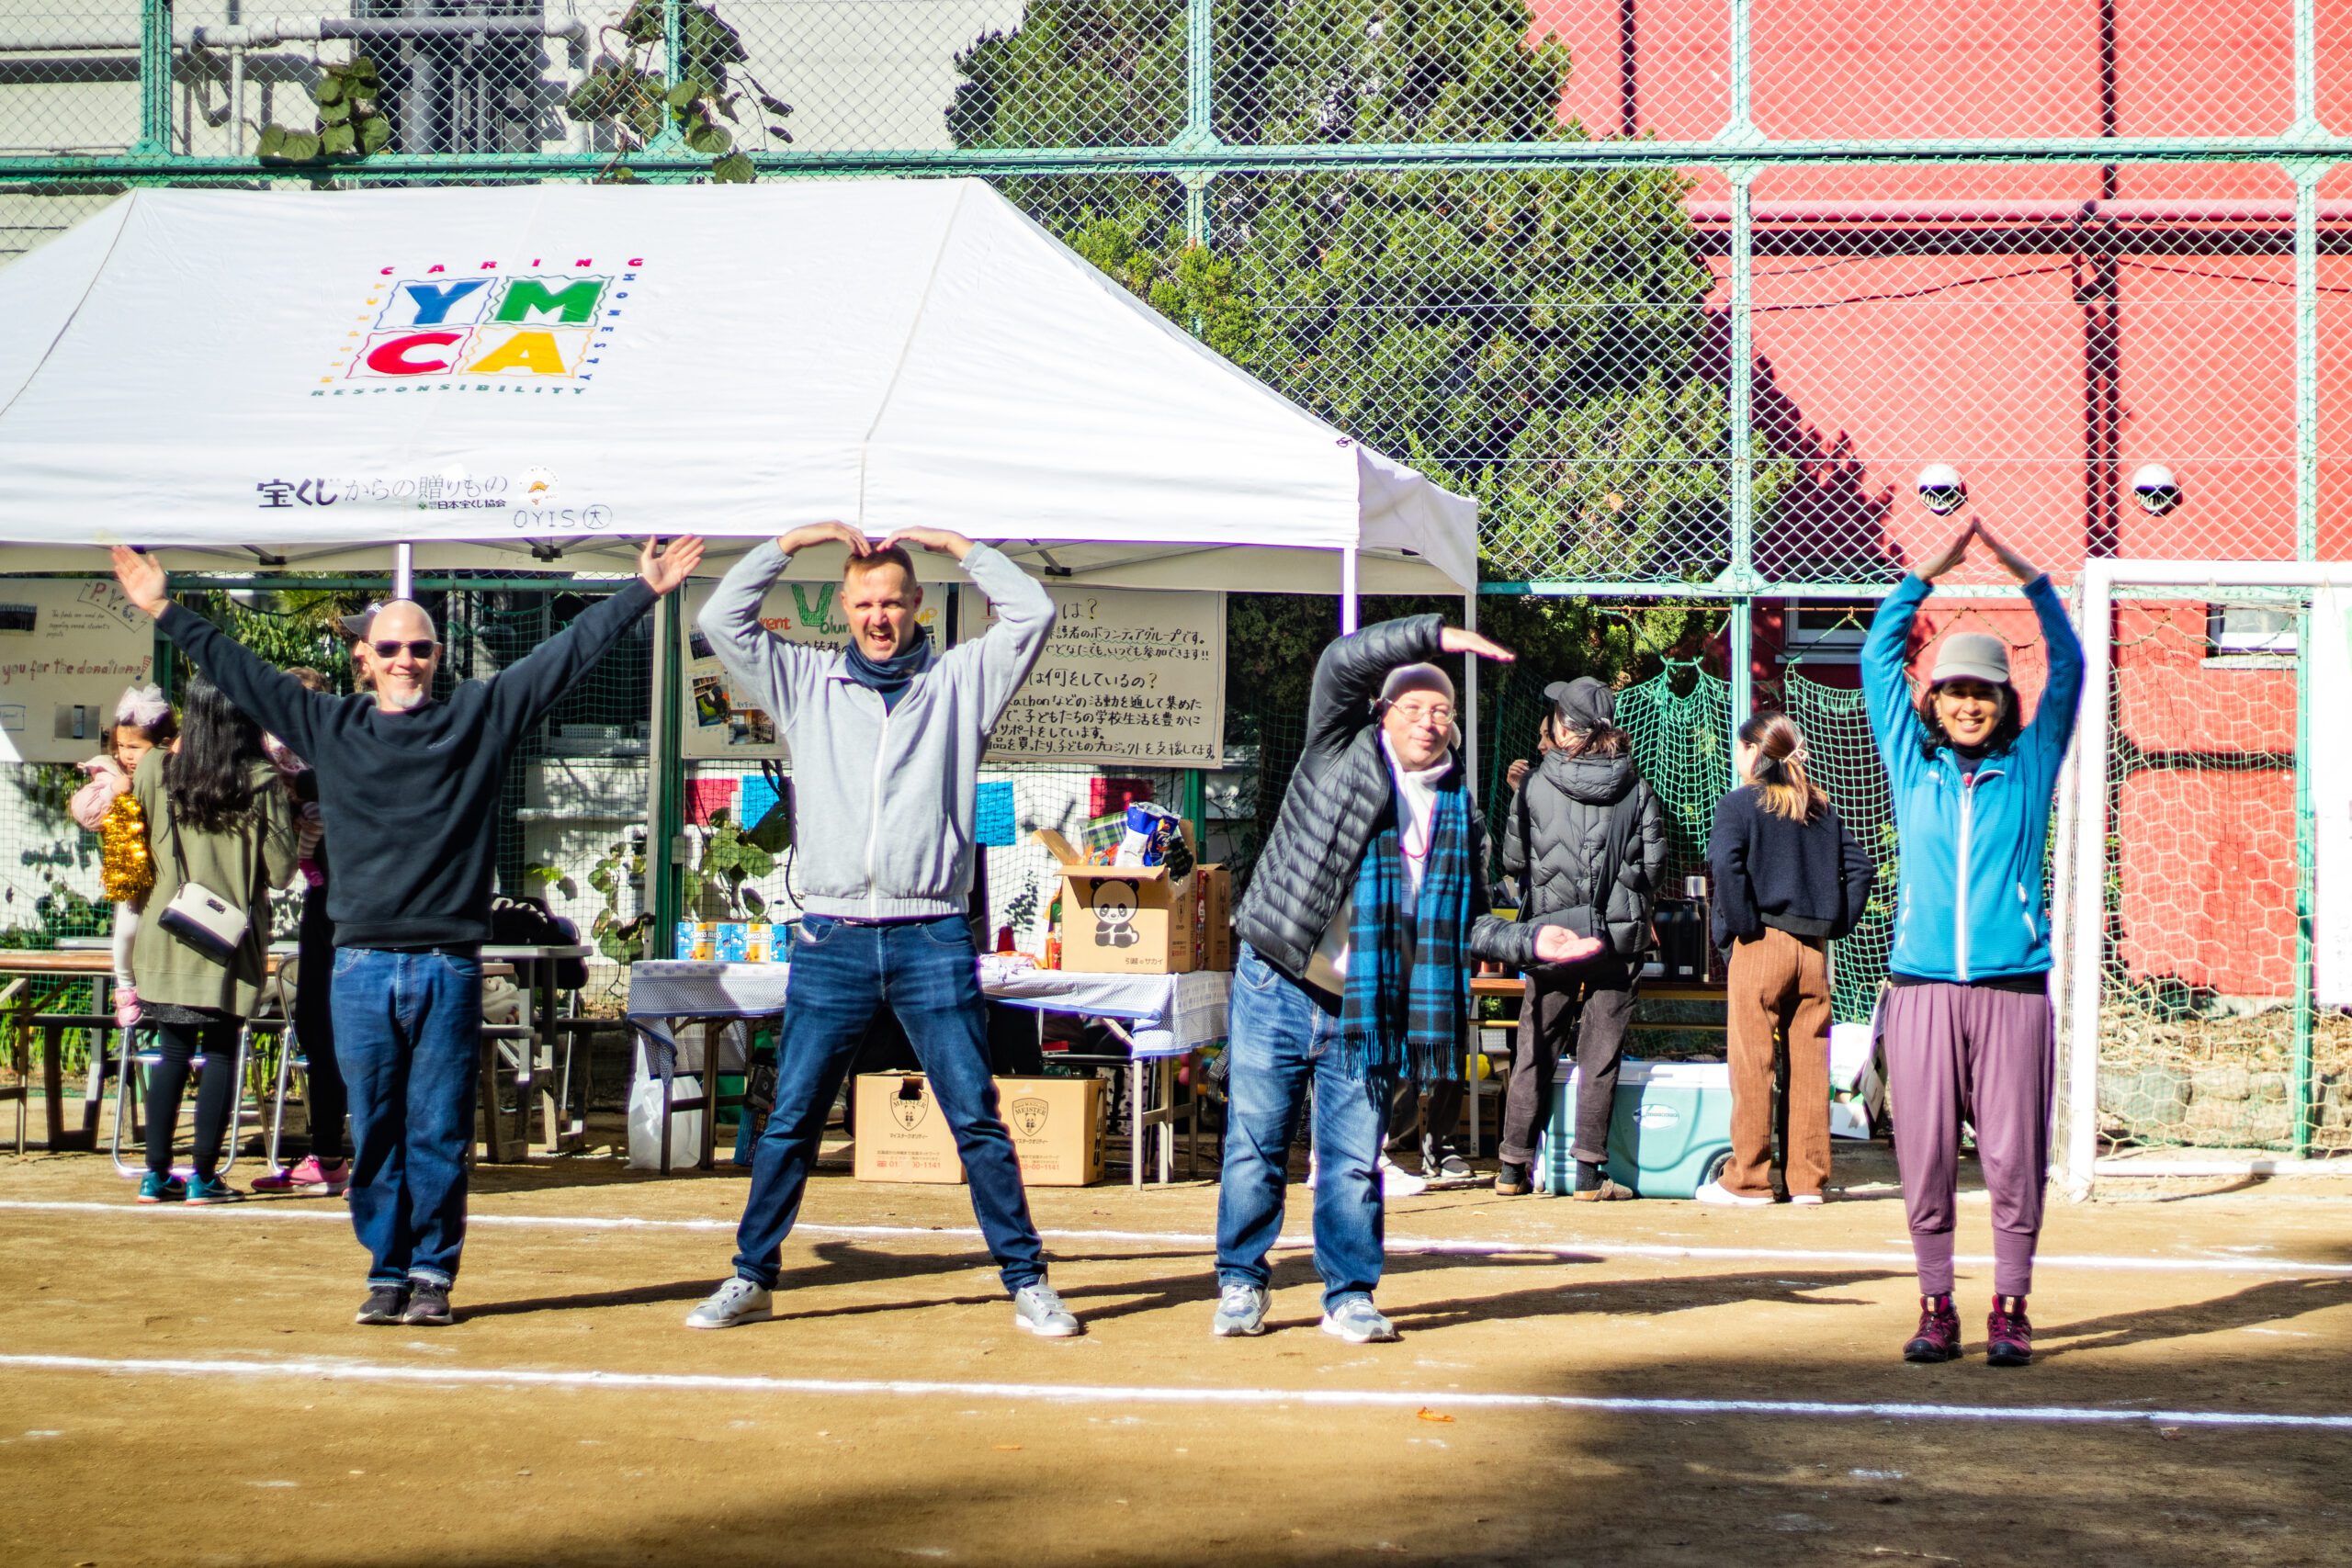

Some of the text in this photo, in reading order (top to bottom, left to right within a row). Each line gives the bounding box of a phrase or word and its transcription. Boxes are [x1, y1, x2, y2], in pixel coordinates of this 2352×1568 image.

[379, 258, 644, 276] CARING
[579, 273, 637, 380] HONESTY
[311, 383, 586, 396] RESPONSIBILITY
[514, 509, 575, 528] OYIS
[1062, 598, 1098, 620] は?
[2, 663, 27, 685] you
[1028, 668, 1158, 689] は何をしているの?
[1005, 708, 1201, 728] で、子どもたちの学校生活を豊かに
[1014, 1107, 1046, 1116] MEISTER
